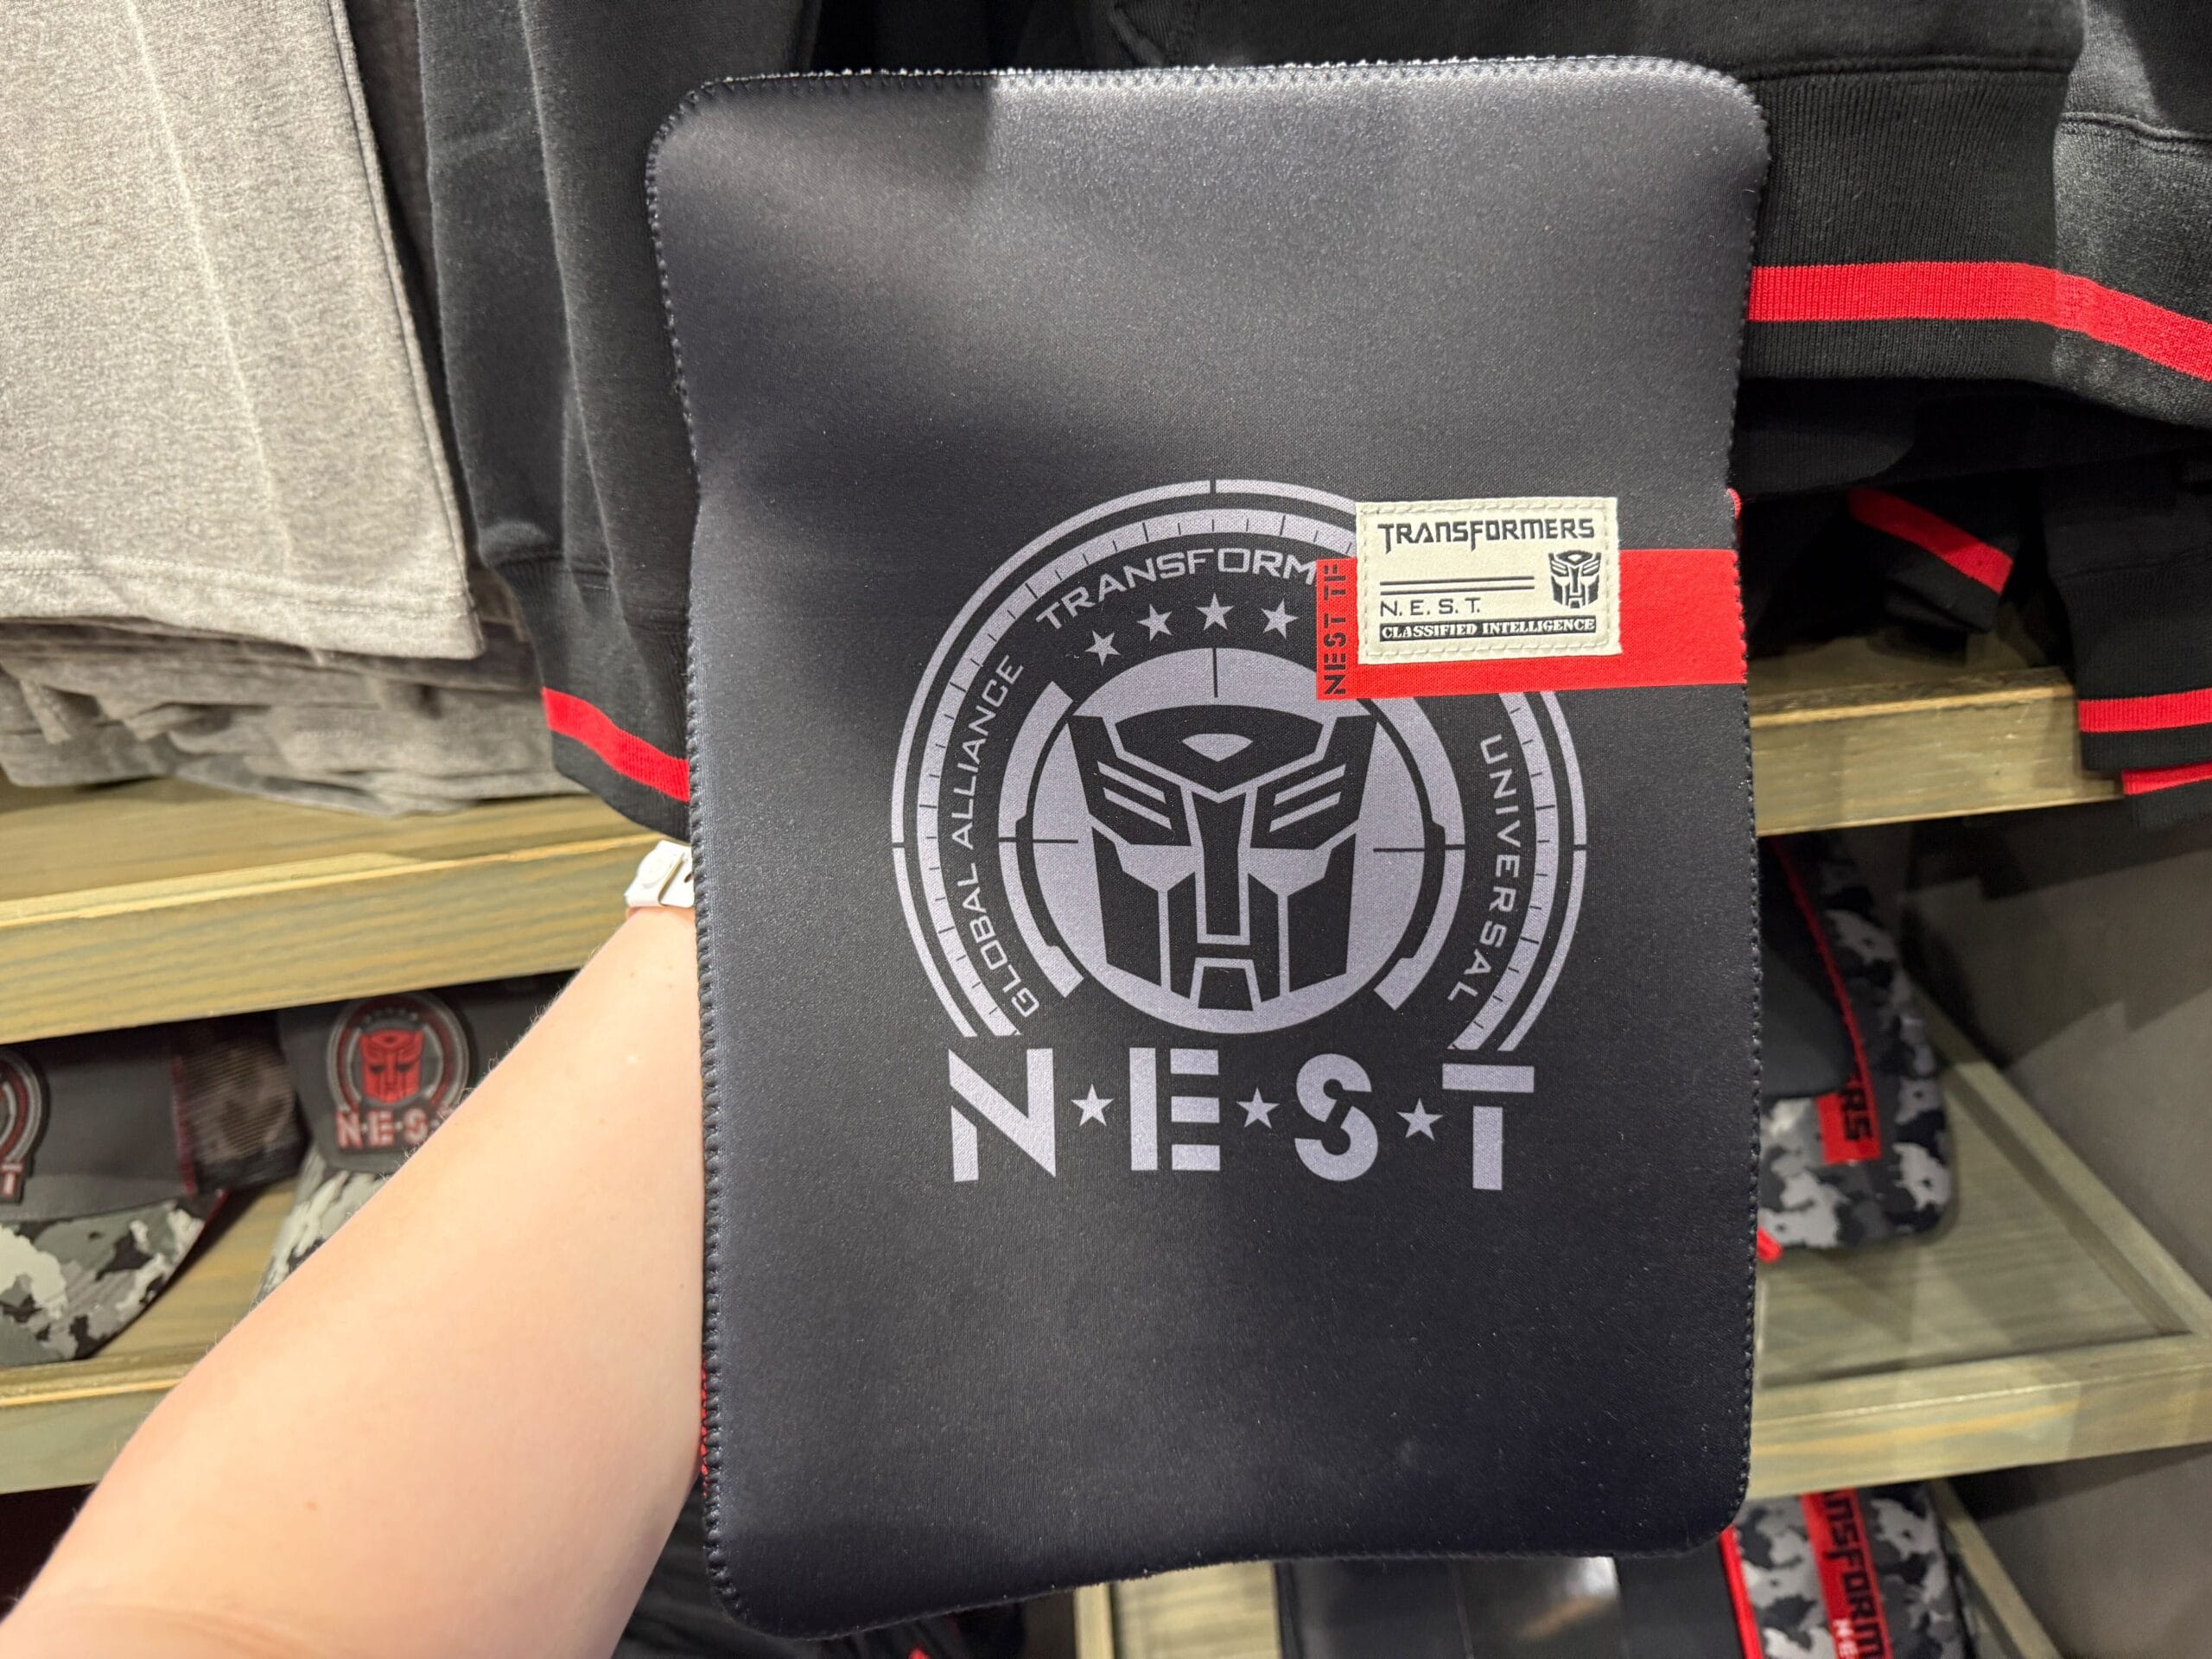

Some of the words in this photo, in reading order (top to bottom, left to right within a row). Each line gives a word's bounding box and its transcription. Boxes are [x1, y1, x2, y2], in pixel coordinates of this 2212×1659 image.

[1377, 518, 1595, 554] TRANSFORMERS
[1324, 613, 1346, 695] NEST
[1382, 623, 1478, 639] CLASSIFIED
[1482, 618, 1595, 635] INTELLIGENCE
[951, 655, 1025, 850] ALLIANCE
[1447, 734, 1521, 1001] UNIVERSAL
[957, 862, 1040, 1019] GLOBAL
